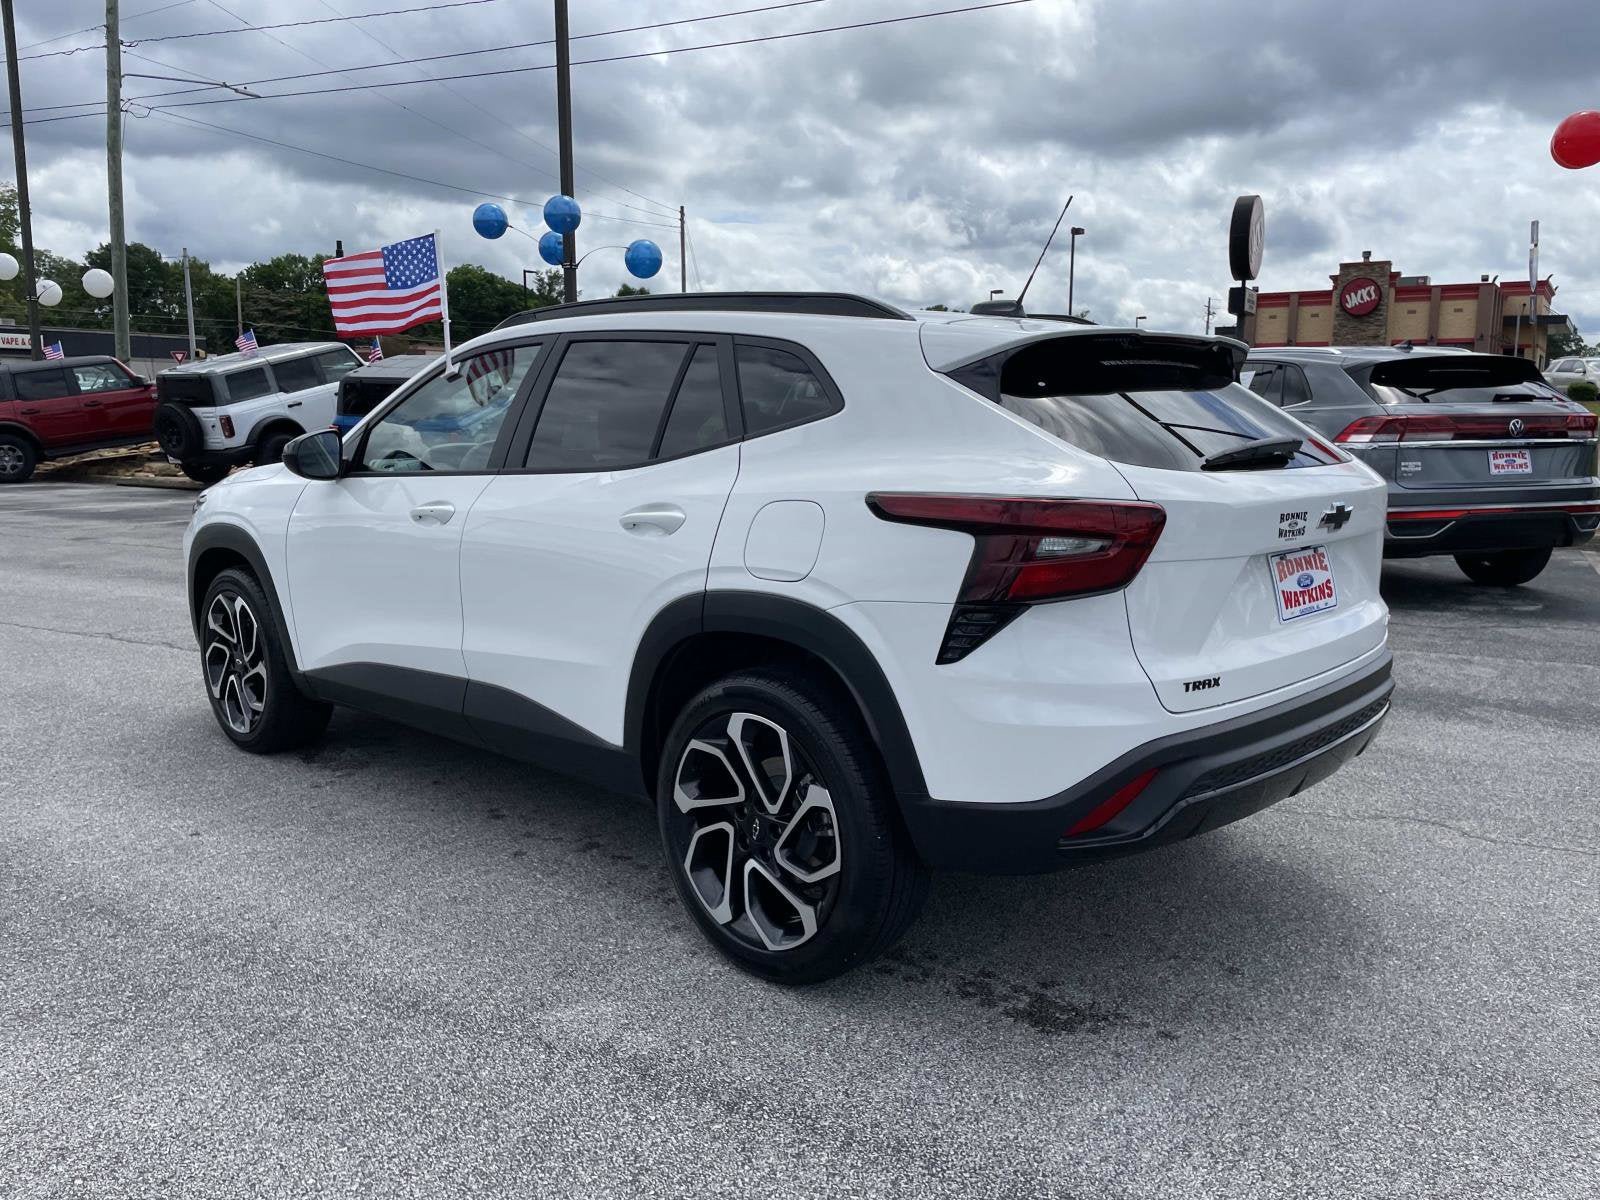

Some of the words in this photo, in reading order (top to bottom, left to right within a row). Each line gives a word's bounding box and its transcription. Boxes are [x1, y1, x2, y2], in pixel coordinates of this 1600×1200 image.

[1, 337, 19, 345] VAPE
[1492, 452, 1527, 460] RONNIE
[1494, 462, 1528, 470] WATKINS
[1280, 511, 1308, 523] RONNIE
[1278, 525, 1306, 538] WATKINS
[1276, 552, 1328, 582] RONNIE
[1281, 579, 1333, 610] WATKINS
[1183, 677, 1220, 692] TRAX
